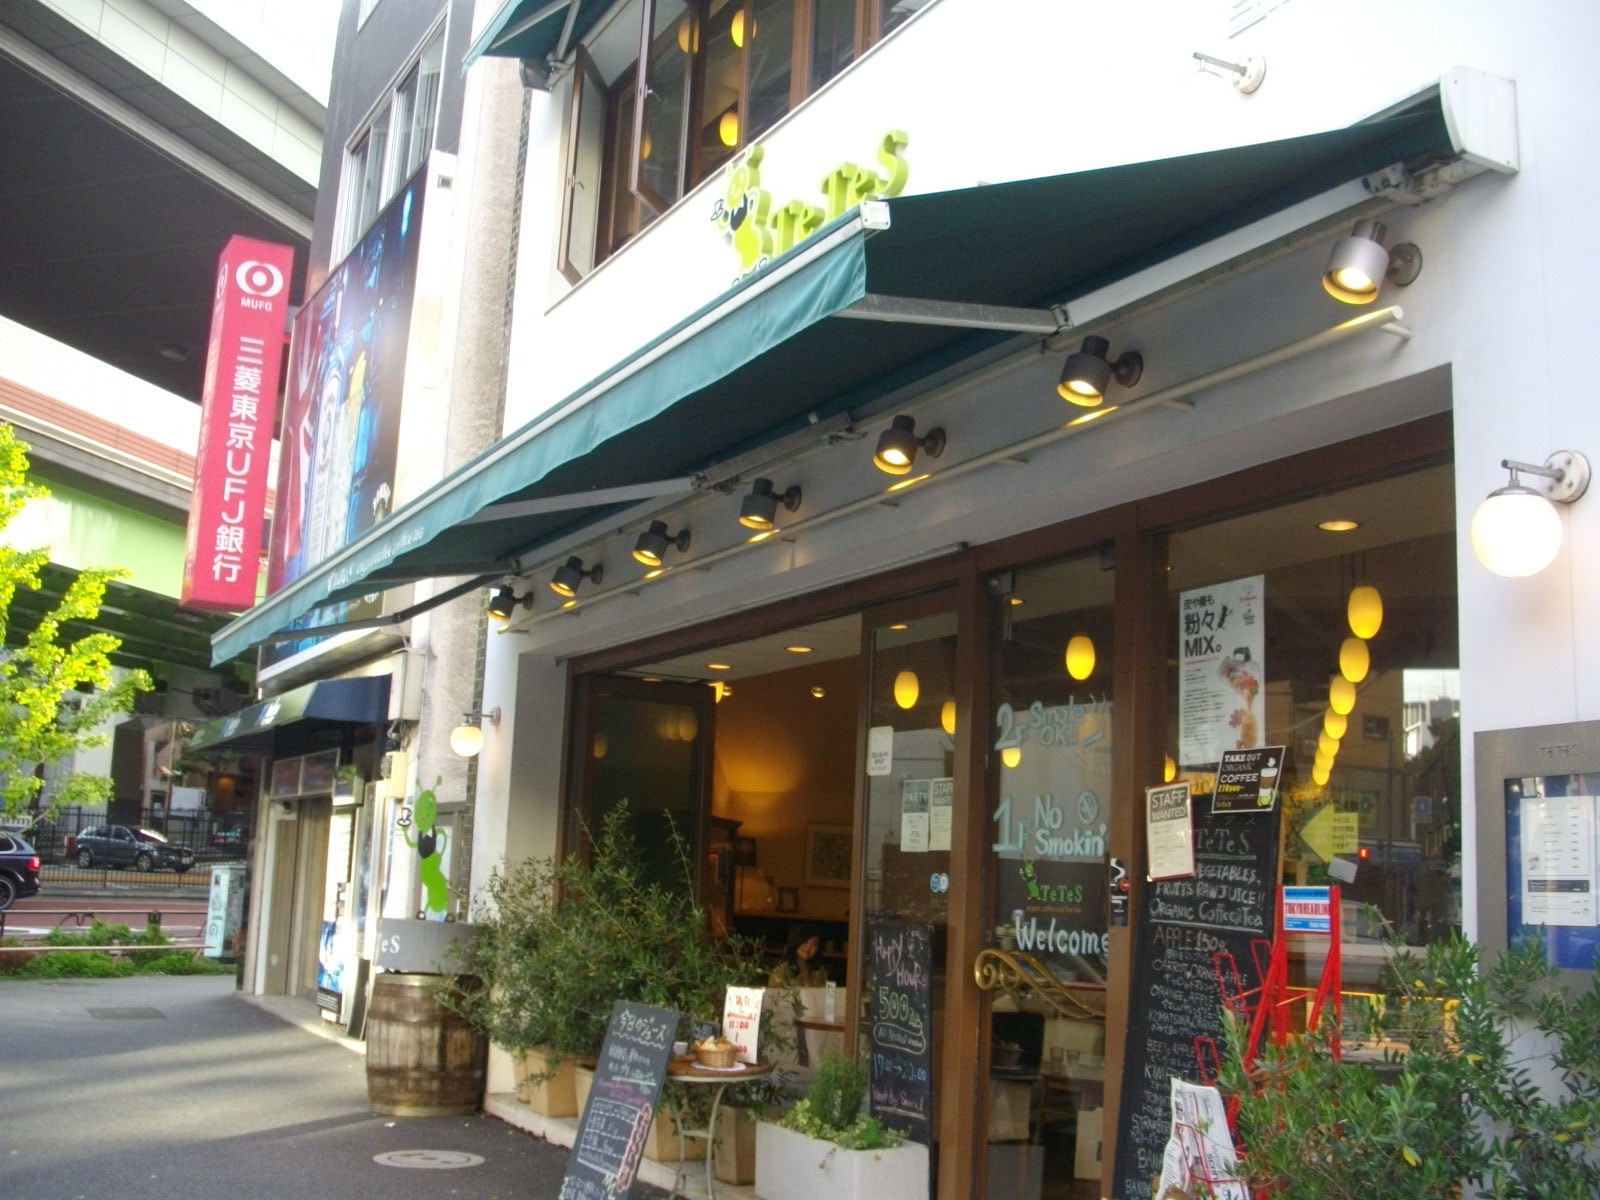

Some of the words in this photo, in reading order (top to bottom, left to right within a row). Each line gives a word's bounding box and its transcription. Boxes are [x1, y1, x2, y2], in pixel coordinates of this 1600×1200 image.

[240, 297, 274, 312] MUFG
[211, 336, 265, 584] 三菱東京UFJ銀行
[1184, 610, 1215, 636] 粉々
[1224, 754, 1247, 763] TAKE
[1220, 772, 1259, 784] COFFEE
[1151, 789, 1186, 809] STAFF
[1035, 794, 1063, 830] No
[1151, 807, 1187, 821] WANTED
[1040, 884, 1083, 903] TeTeS
[1149, 897, 1194, 920] ORGANIC
[1015, 914, 1109, 957] Welcome
[879, 986, 910, 1021] 500
[619, 1009, 667, 1042] 今日のジュース
